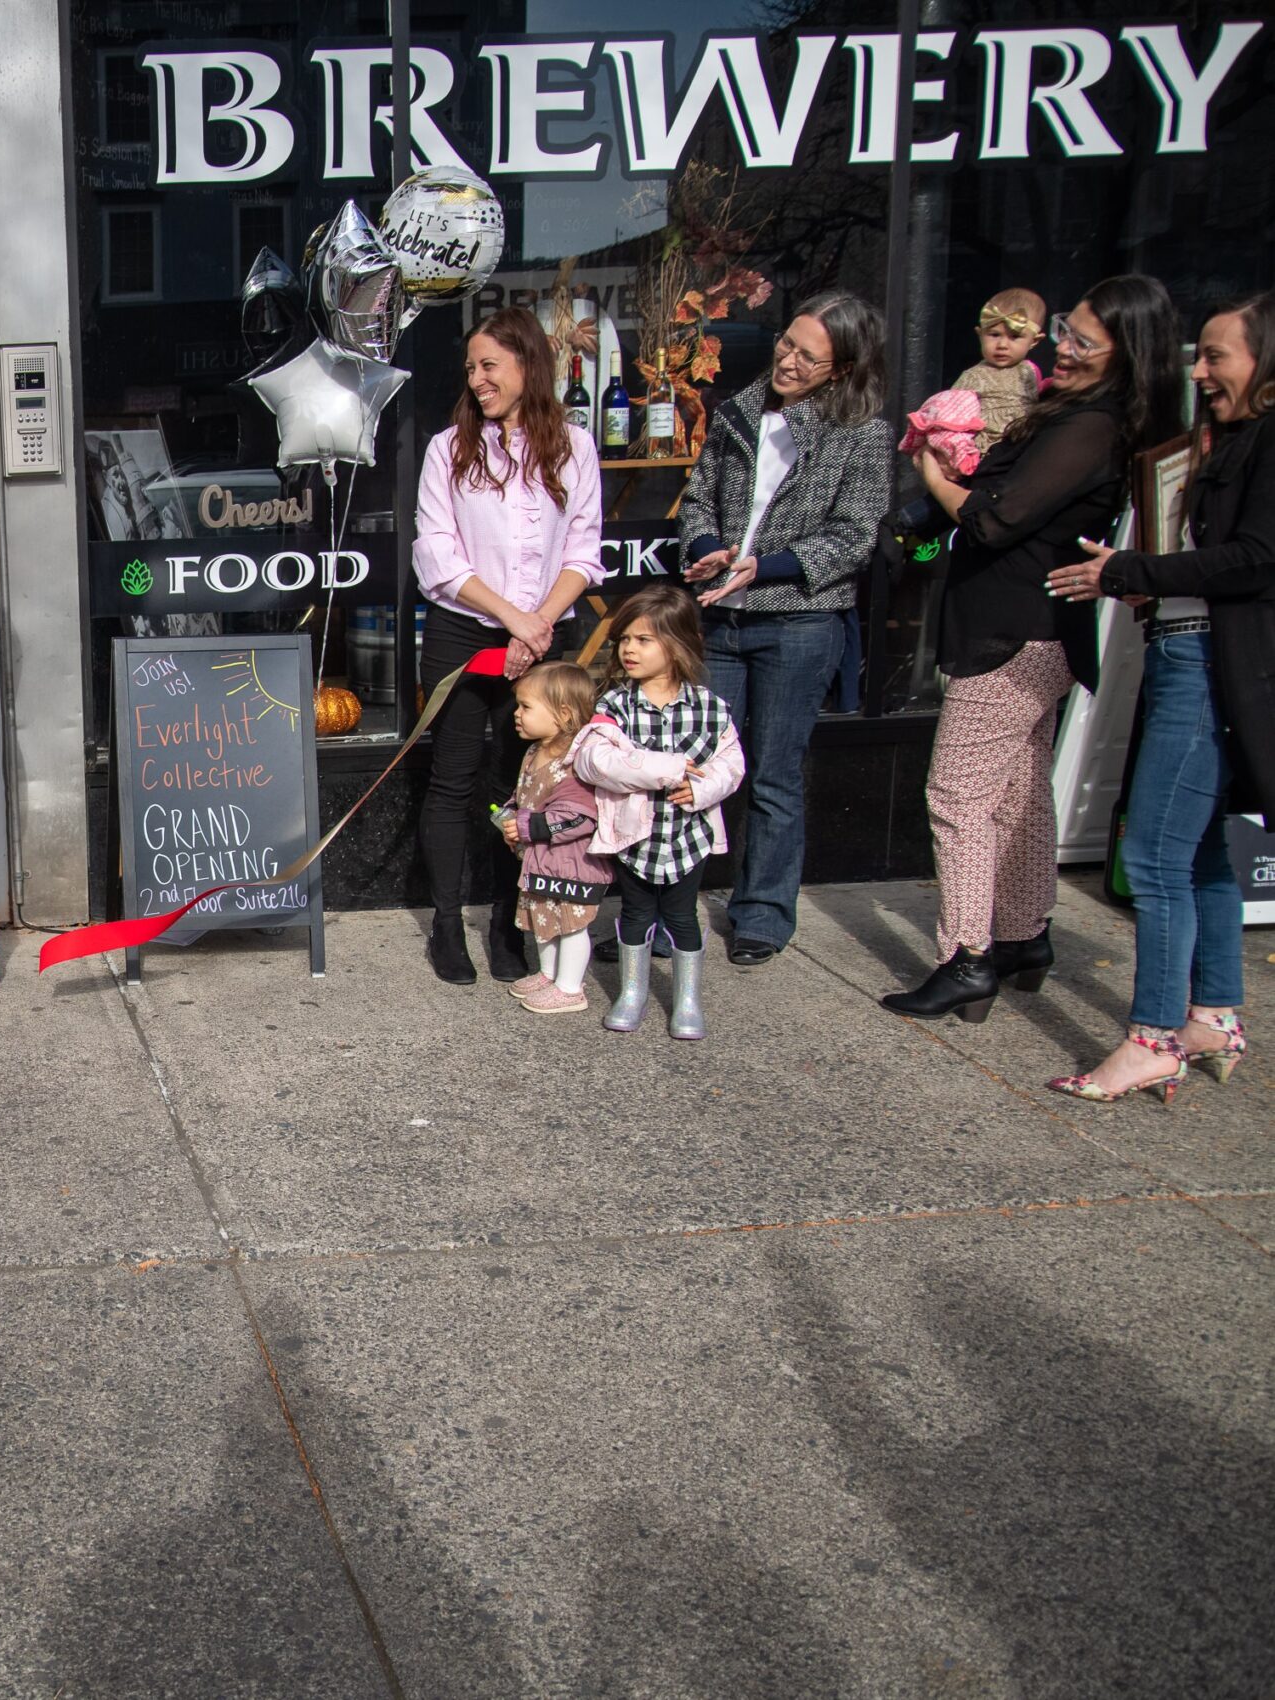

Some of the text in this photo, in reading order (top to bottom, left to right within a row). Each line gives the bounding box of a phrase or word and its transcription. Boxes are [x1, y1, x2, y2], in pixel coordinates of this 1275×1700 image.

[142, 22, 1264, 184] BREWERY
[409, 209, 450, 232] LET'S
[198, 484, 313, 529] Cheers!
[165, 551, 370, 594] FOOD
[132, 654, 180, 687] JOIN
[164, 671, 196, 697] US!
[135, 702, 257, 760] Everlight
[141, 758, 273, 791] Collective
[143, 803, 251, 851] GRAND
[152, 847, 278, 886] OPENING
[139, 885, 181, 916] 2nd
[183, 887, 228, 915] Floor
[235, 887, 280, 910] Suite
[534, 877, 594, 898] DKNY
